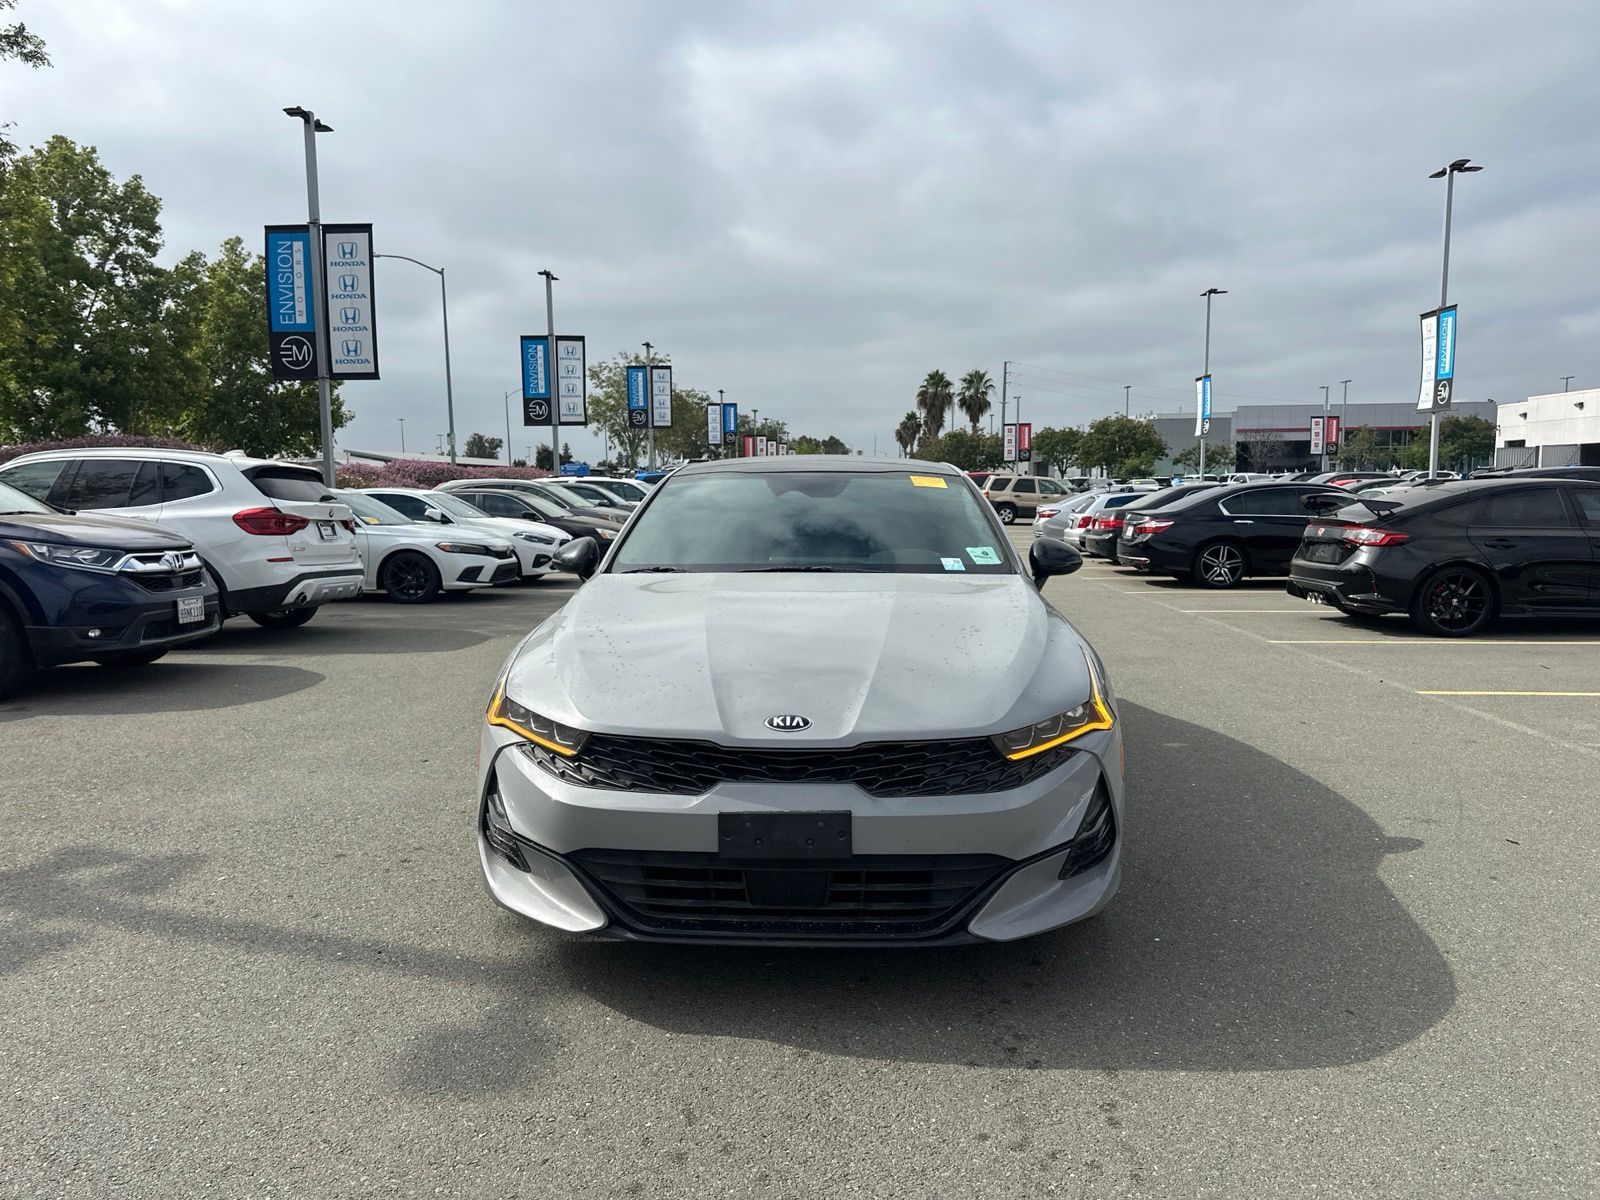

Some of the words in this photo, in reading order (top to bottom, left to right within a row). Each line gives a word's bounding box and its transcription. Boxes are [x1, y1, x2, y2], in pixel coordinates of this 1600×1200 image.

[277, 241, 295, 324] ENVISION
[295, 248, 304, 317] MOTORS
[528, 344, 539, 394] ENVISION
[773, 716, 804, 727] KIA
